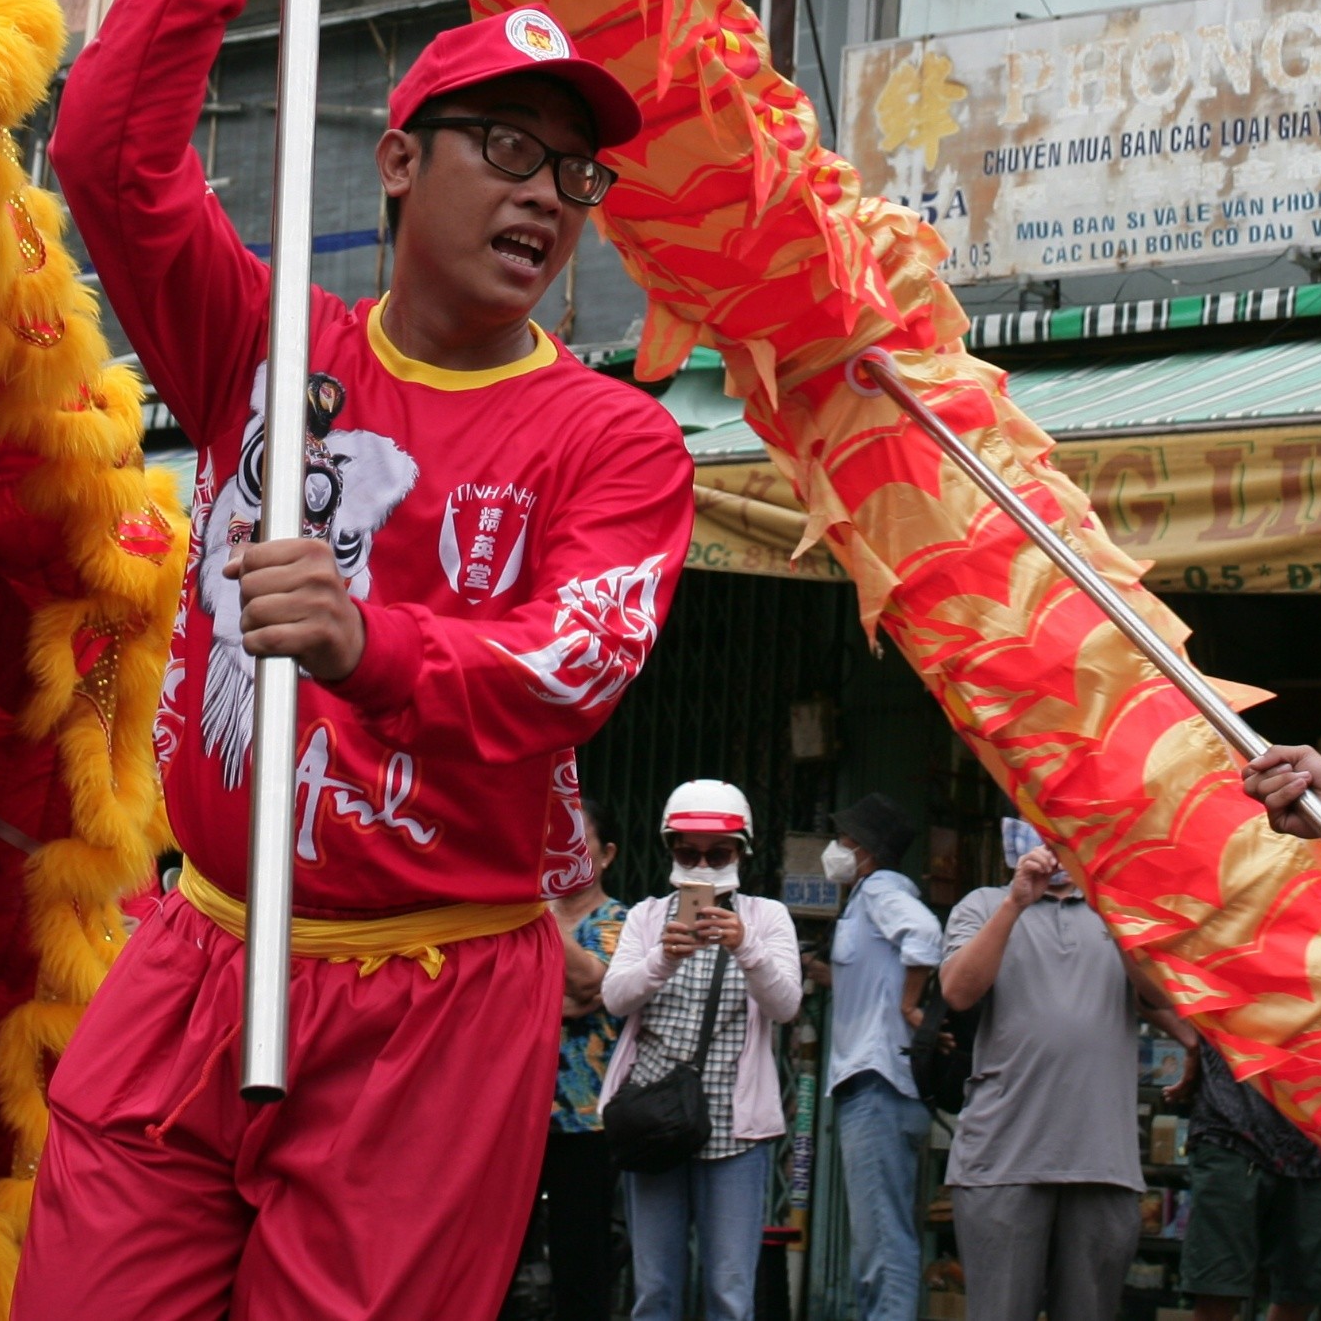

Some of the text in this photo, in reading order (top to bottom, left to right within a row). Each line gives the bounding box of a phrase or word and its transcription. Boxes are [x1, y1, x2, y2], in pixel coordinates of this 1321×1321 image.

[983, 137, 1062, 176] CHUYÊN
[1068, 135, 1112, 165] MUA
[1120, 121, 1163, 158] BÁN
[1170, 115, 1212, 153] CÁC
[1221, 116, 1270, 150] LOẠI
[1015, 219, 1065, 241] MUA
[455, 482, 501, 502] TINH
